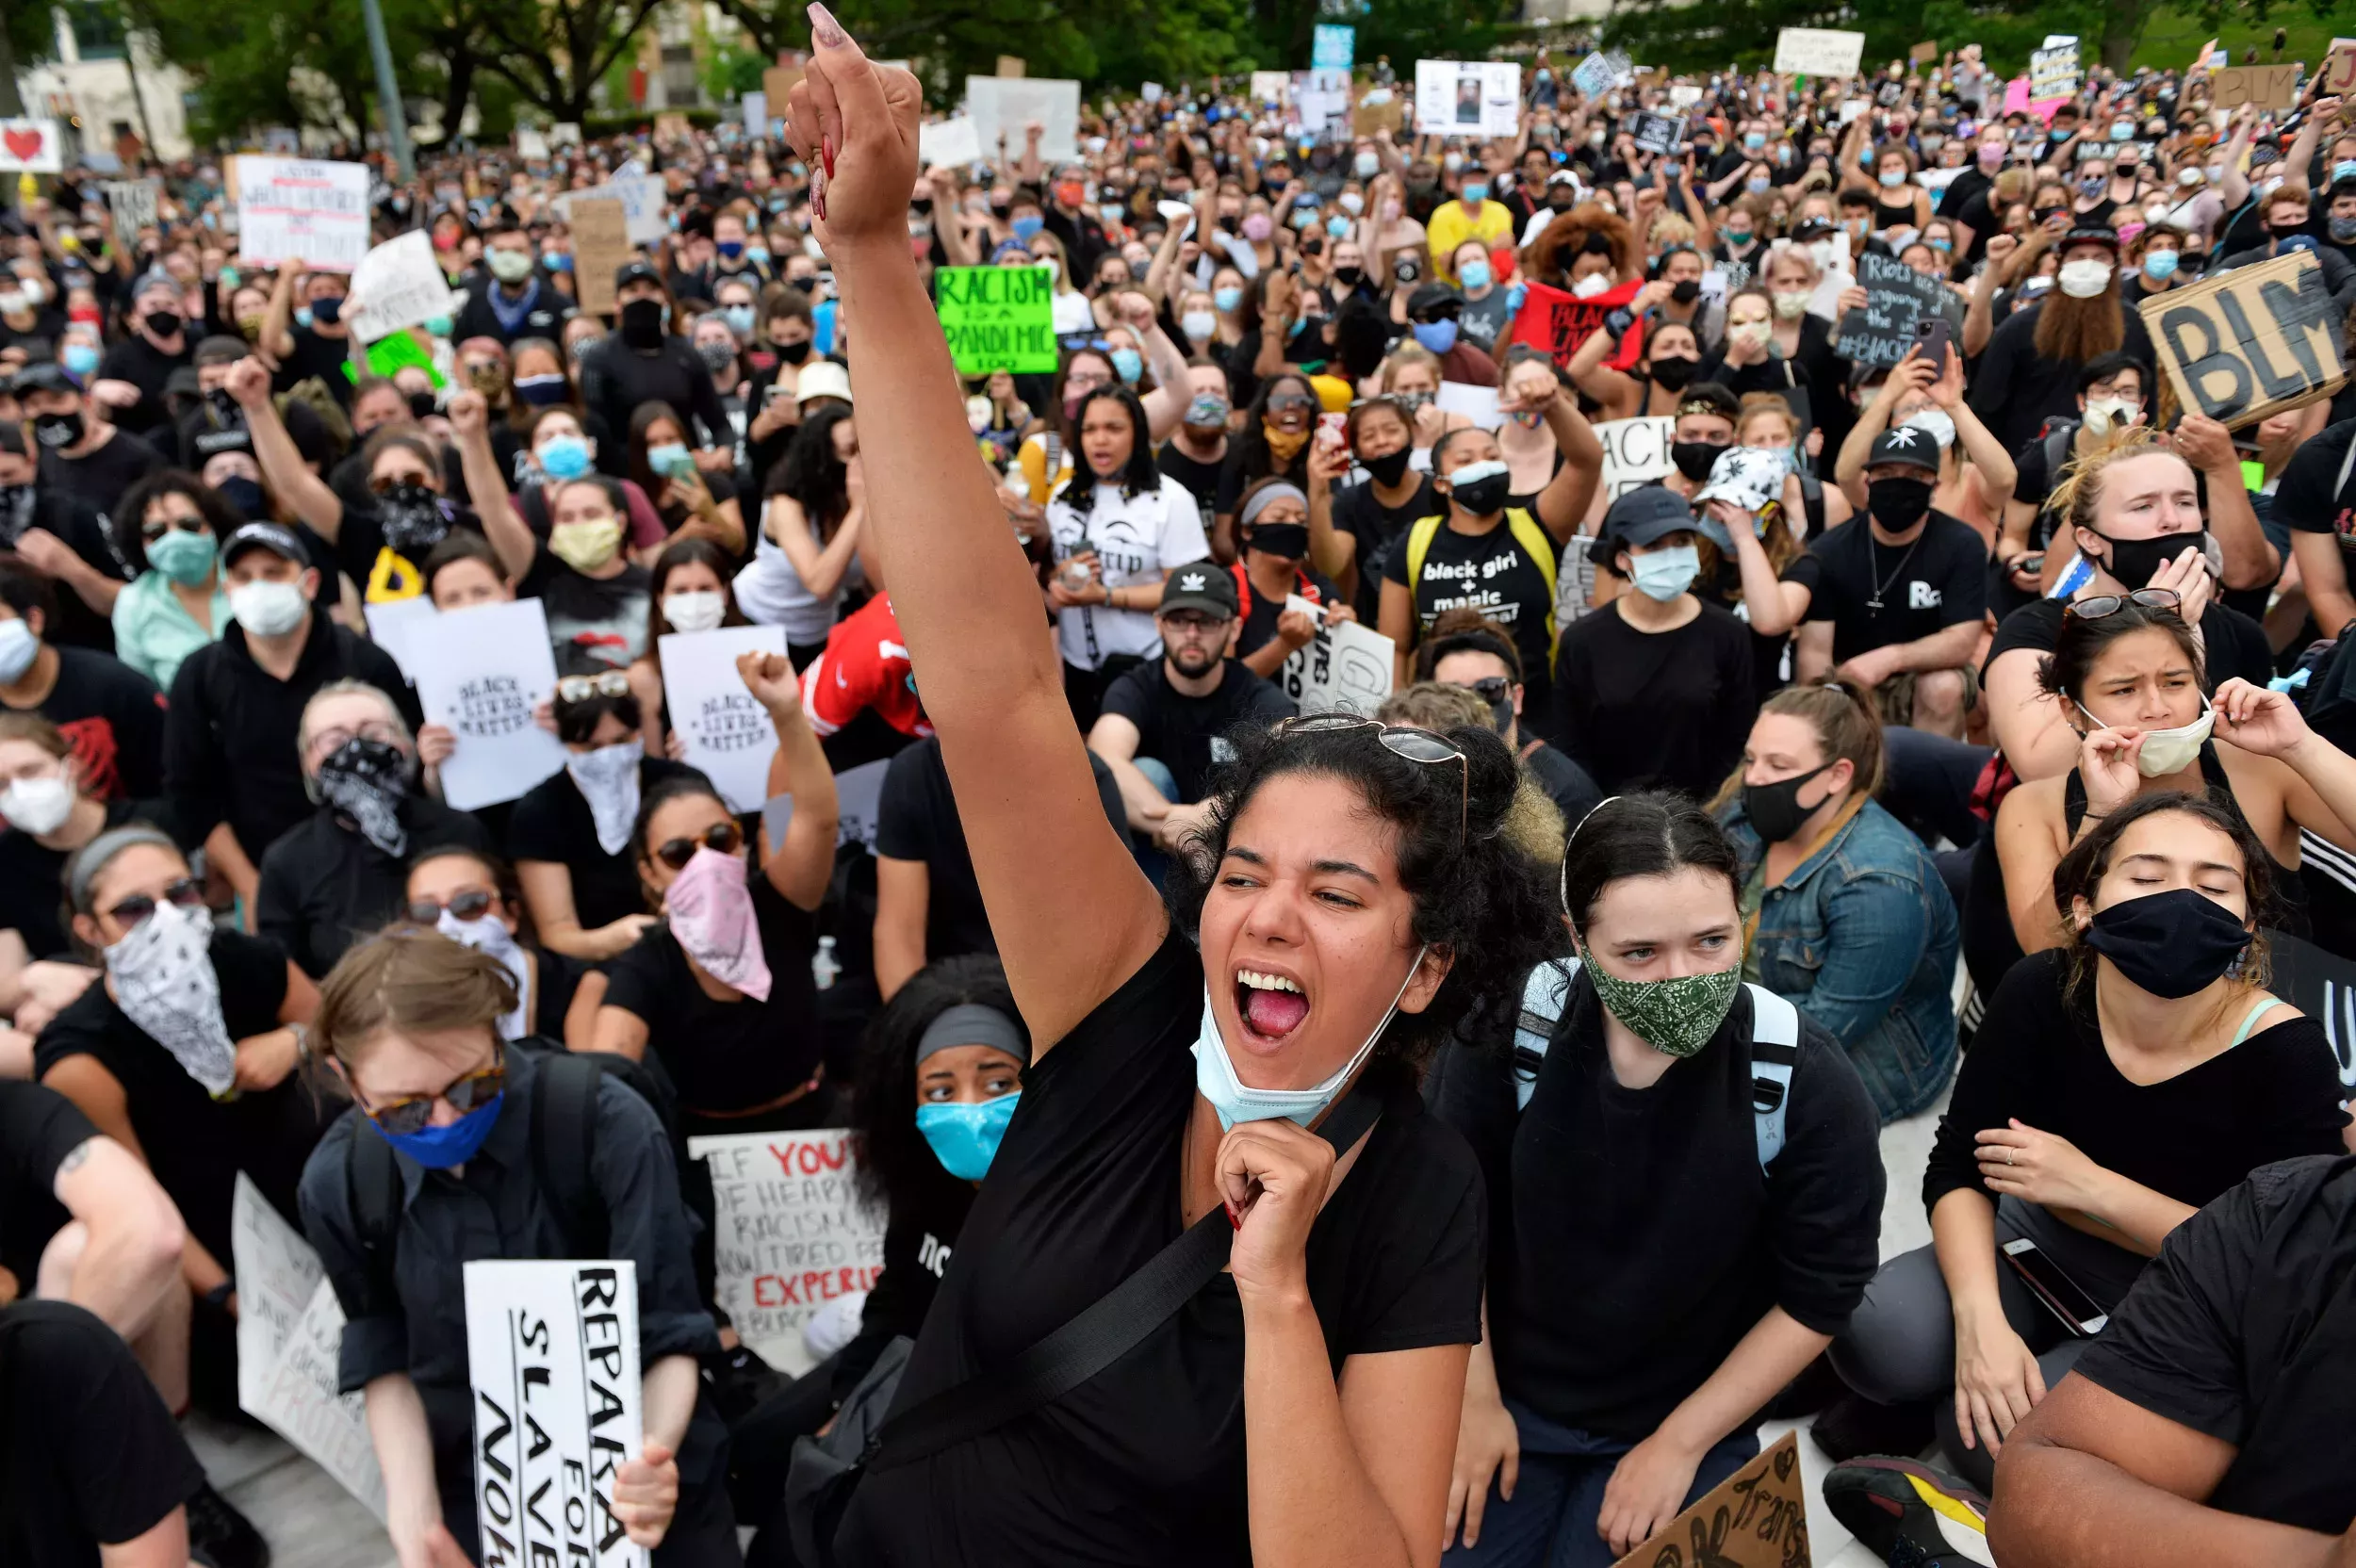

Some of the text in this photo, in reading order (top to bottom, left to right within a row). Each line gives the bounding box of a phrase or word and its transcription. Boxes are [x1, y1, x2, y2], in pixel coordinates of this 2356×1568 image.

[2223, 68, 2291, 106] BLM
[936, 270, 1051, 304] RACISM
[1867, 289, 1923, 321] anguage
[2160, 256, 2345, 418] BLM
[1424, 550, 1518, 580] black girl
[578, 1268, 630, 1568] REPARA
